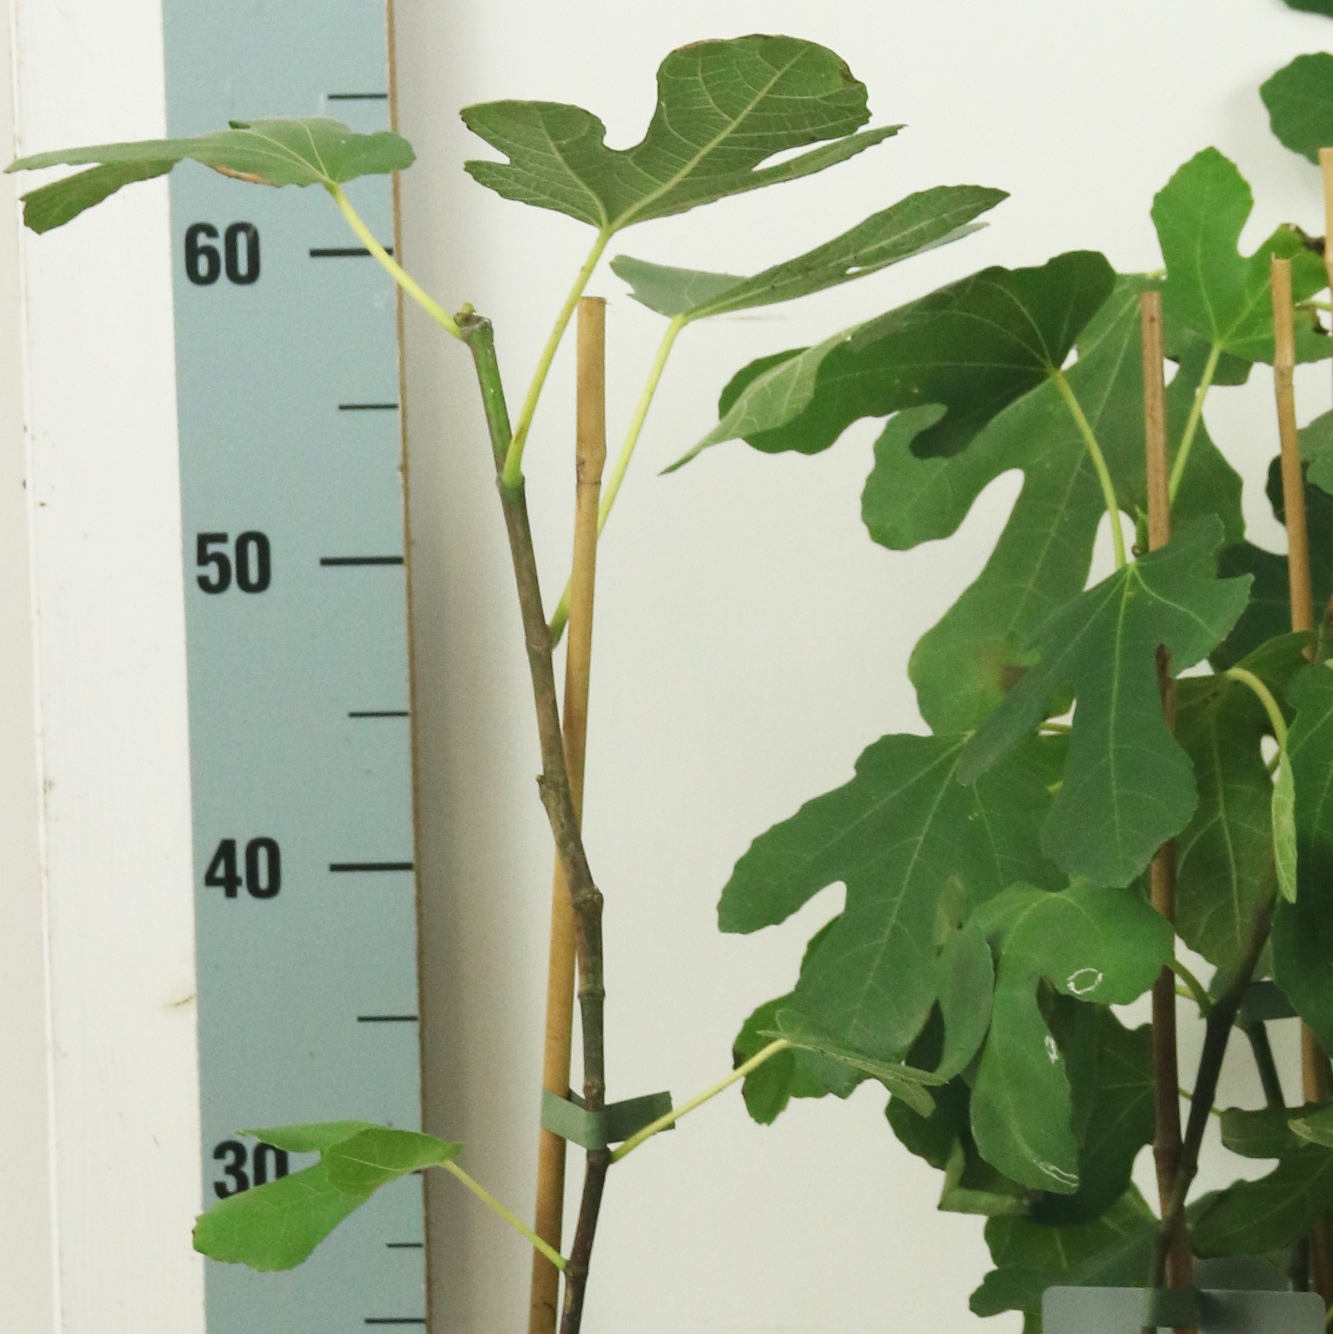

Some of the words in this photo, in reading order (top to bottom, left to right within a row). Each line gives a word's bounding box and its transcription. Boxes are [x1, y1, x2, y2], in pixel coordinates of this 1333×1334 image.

[185, 221, 261, 286] 60
[196, 530, 271, 594] 50
[205, 836, 282, 899] 40
[213, 1140, 289, 1200] 30
